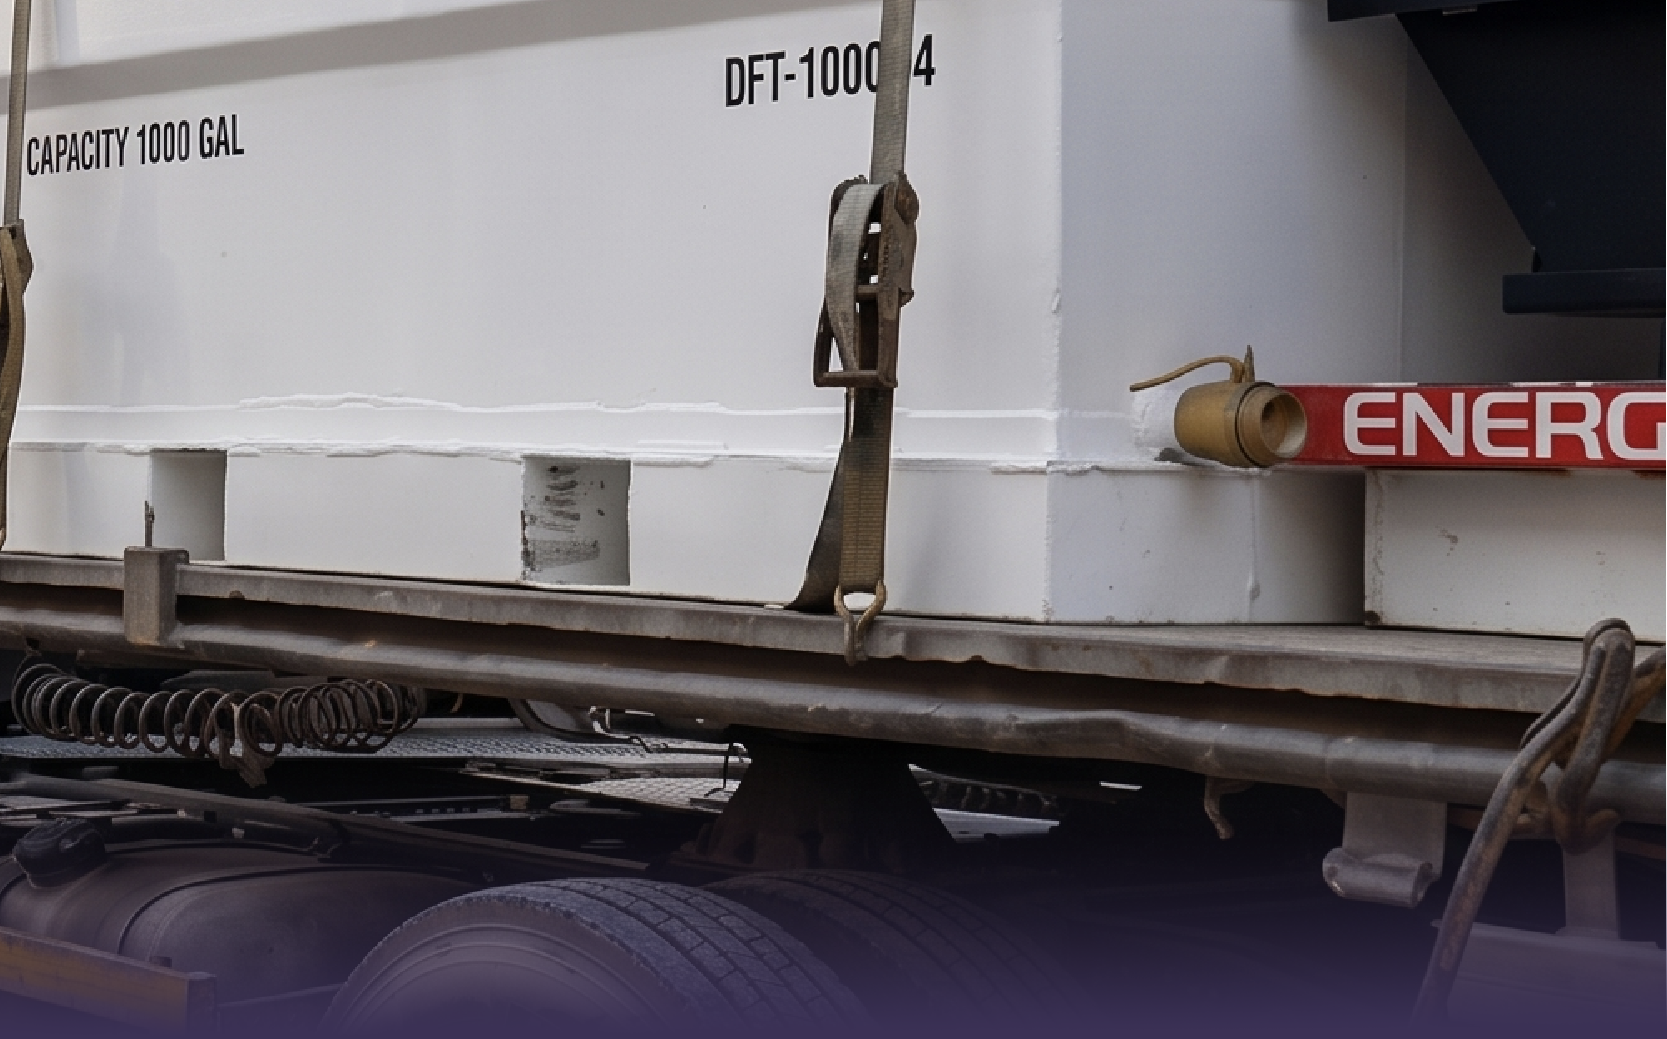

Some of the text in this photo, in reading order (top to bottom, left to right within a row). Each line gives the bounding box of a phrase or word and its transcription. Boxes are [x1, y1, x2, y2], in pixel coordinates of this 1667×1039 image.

[725, 33, 936, 108] DFT-10004
[26, 113, 245, 176] CAPACITY 1000 GAL
[1343, 391, 1666, 461] ENERG
